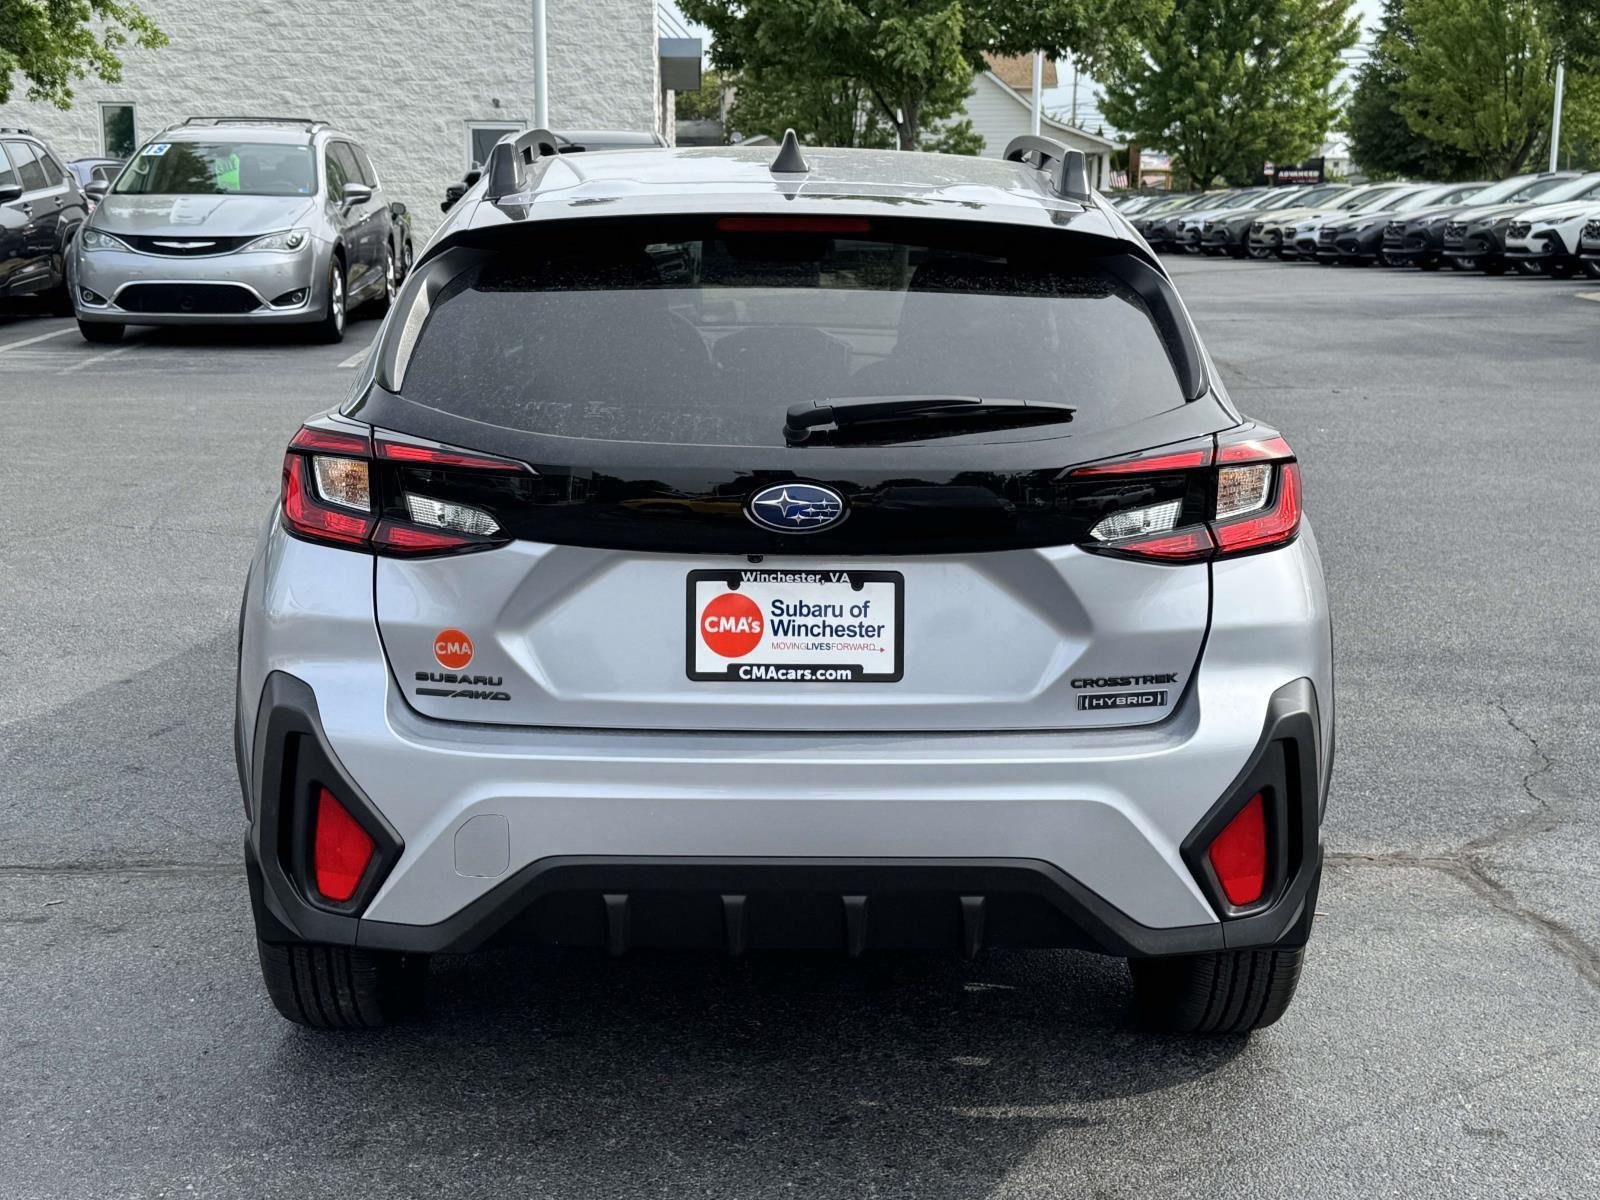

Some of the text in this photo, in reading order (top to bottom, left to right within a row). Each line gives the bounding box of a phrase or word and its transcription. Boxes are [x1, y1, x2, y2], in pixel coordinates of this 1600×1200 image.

[741, 572, 850, 585] Winchester, VA
[771, 599, 871, 618] Subaru of
[704, 616, 761, 634] CMA's
[770, 619, 885, 638] Winchester
[435, 641, 471, 655] CMA
[415, 672, 502, 686] SUBARU
[738, 665, 852, 680] CMAcars.com
[1071, 673, 1178, 688] CROSSTREK
[451, 689, 511, 701] AWD
[1092, 695, 1154, 706] HYBRID
